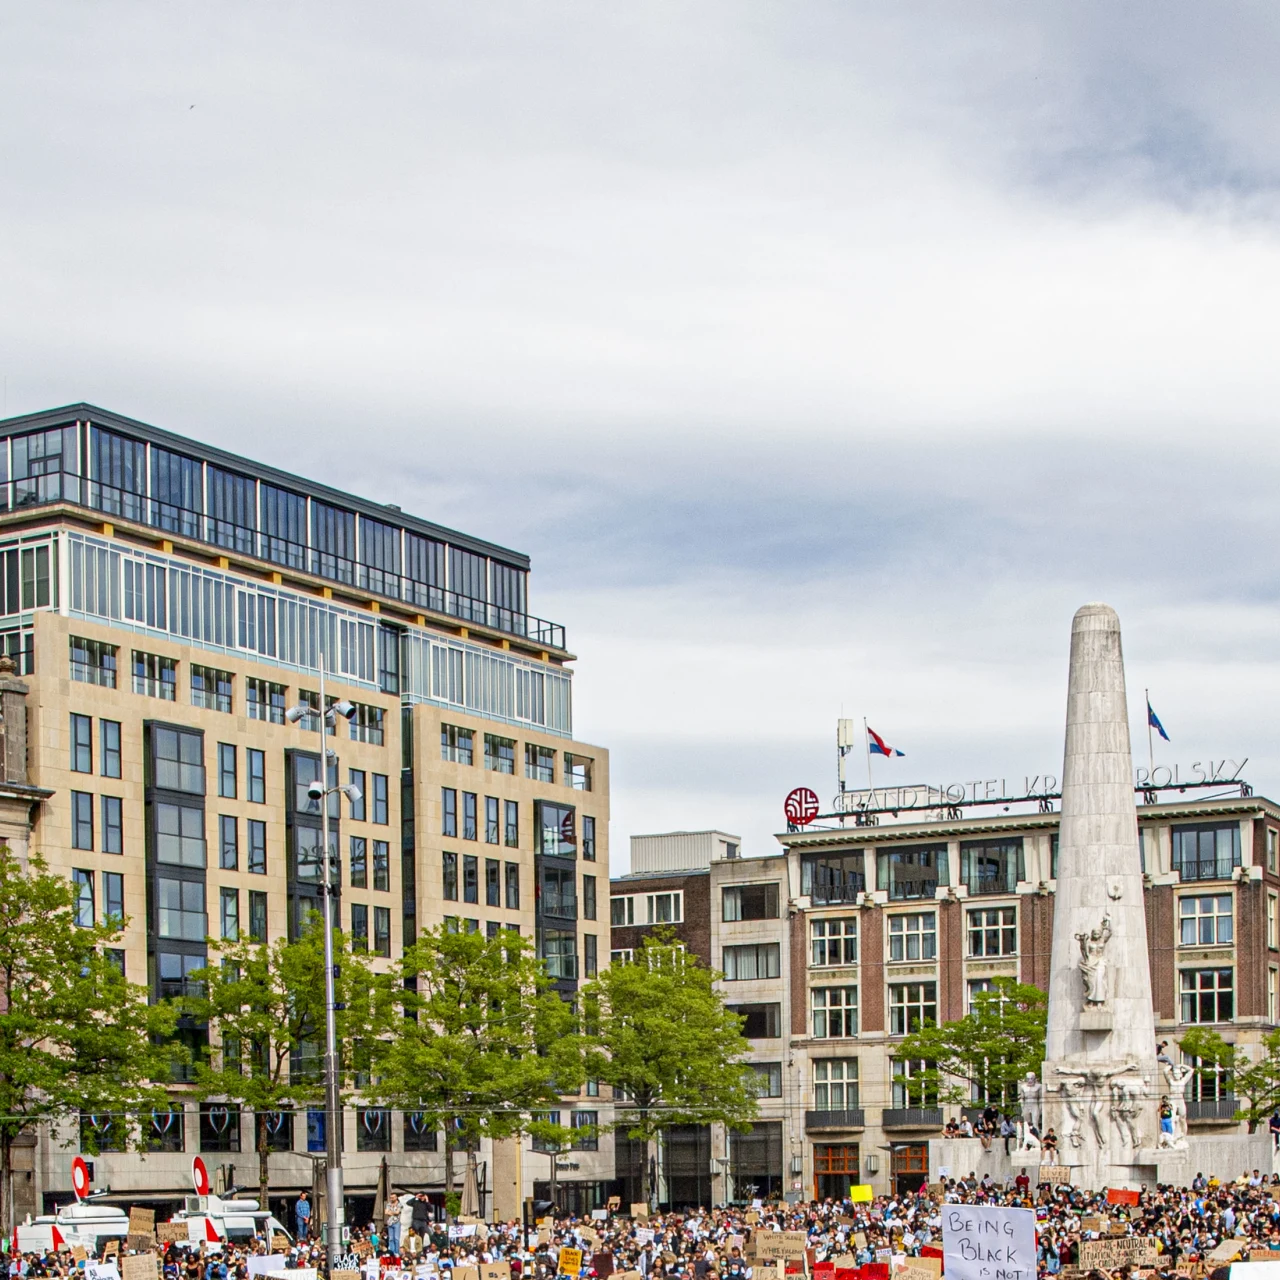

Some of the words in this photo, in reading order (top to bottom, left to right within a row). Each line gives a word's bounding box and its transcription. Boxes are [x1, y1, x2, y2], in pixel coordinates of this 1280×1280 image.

[832, 782, 918, 814] GRAND
[928, 777, 1013, 807] HOTEL
[958, 1239, 1017, 1261] BLACK
[996, 1270, 1023, 1280] NOT
